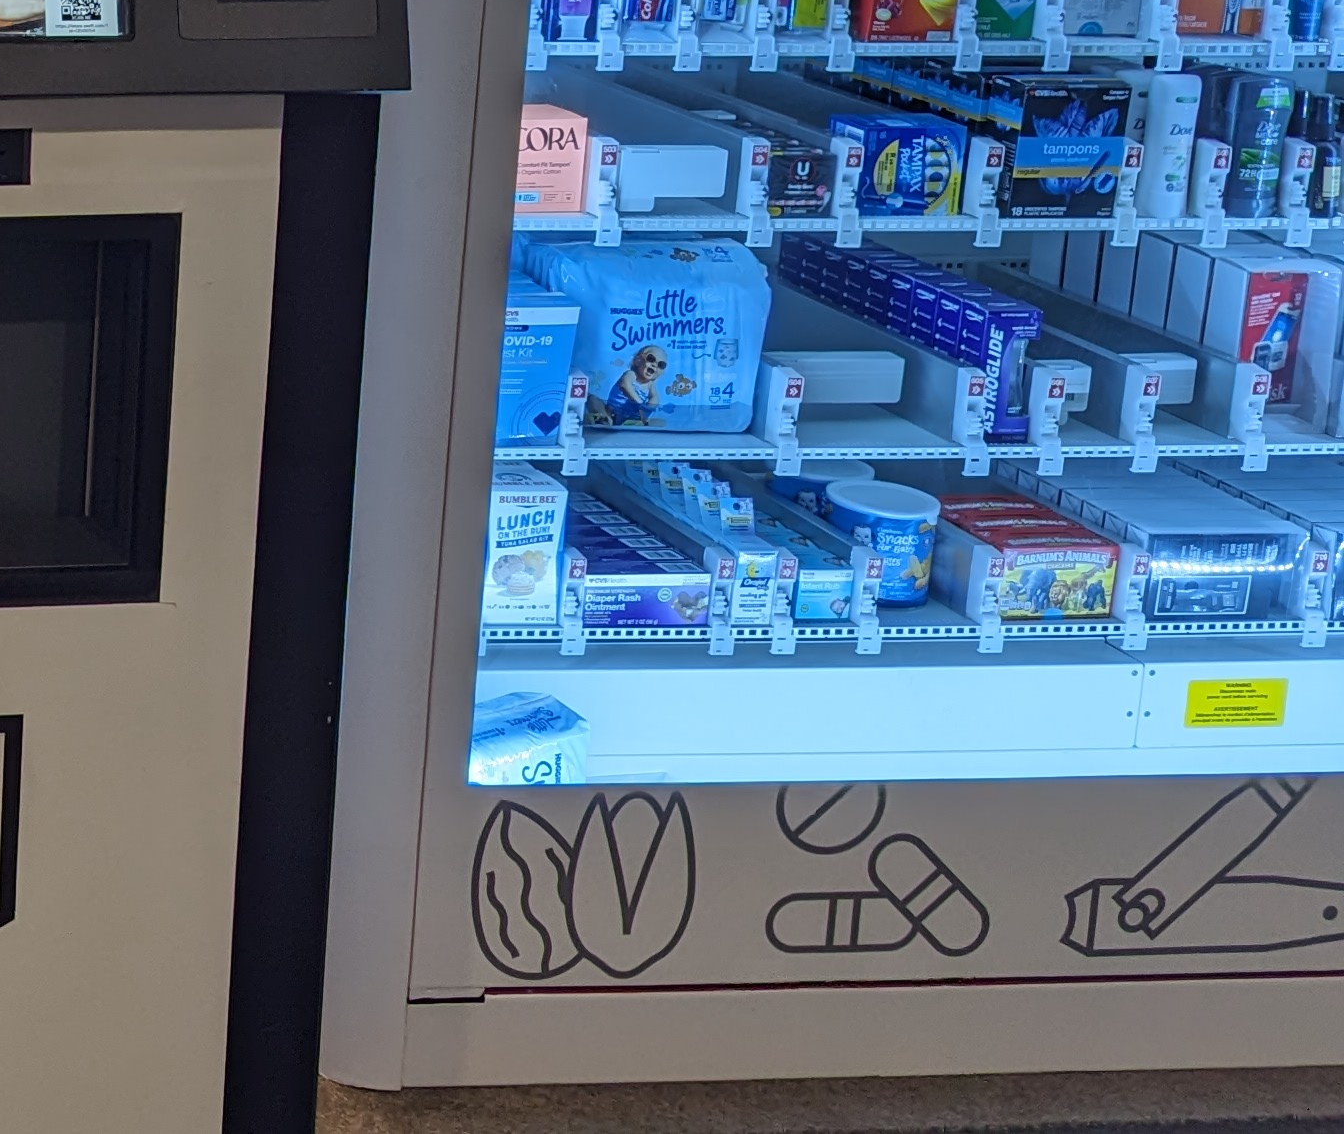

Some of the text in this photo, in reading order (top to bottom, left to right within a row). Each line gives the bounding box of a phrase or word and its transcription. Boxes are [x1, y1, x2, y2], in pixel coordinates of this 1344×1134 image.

[1043, 143, 1100, 155] tampons
[910, 135, 924, 193] TAMPAX
[1012, 207, 1023, 216] 18
[610, 288, 698, 319] HUGGIES Little
[518, 348, 534, 358] Kit
[982, 322, 1005, 435] ASTROGLIDE
[721, 382, 735, 397] 4
[499, 495, 558, 504] BUMBLE BEE
[496, 509, 555, 532] LUNCH
[497, 525, 551, 540] ON THE RUN!
[877, 532, 920, 546] Snacks
[720, 559, 734, 567] 704
[781, 559, 795, 567] 705
[1016, 550, 1108, 565] BARNUM'S ANIMALS
[1314, 553, 1328, 561] 709
[800, 582, 840, 590] Infant Rub
[585, 593, 642, 605] Diaper Rash
[584, 603, 626, 612] Ointment
